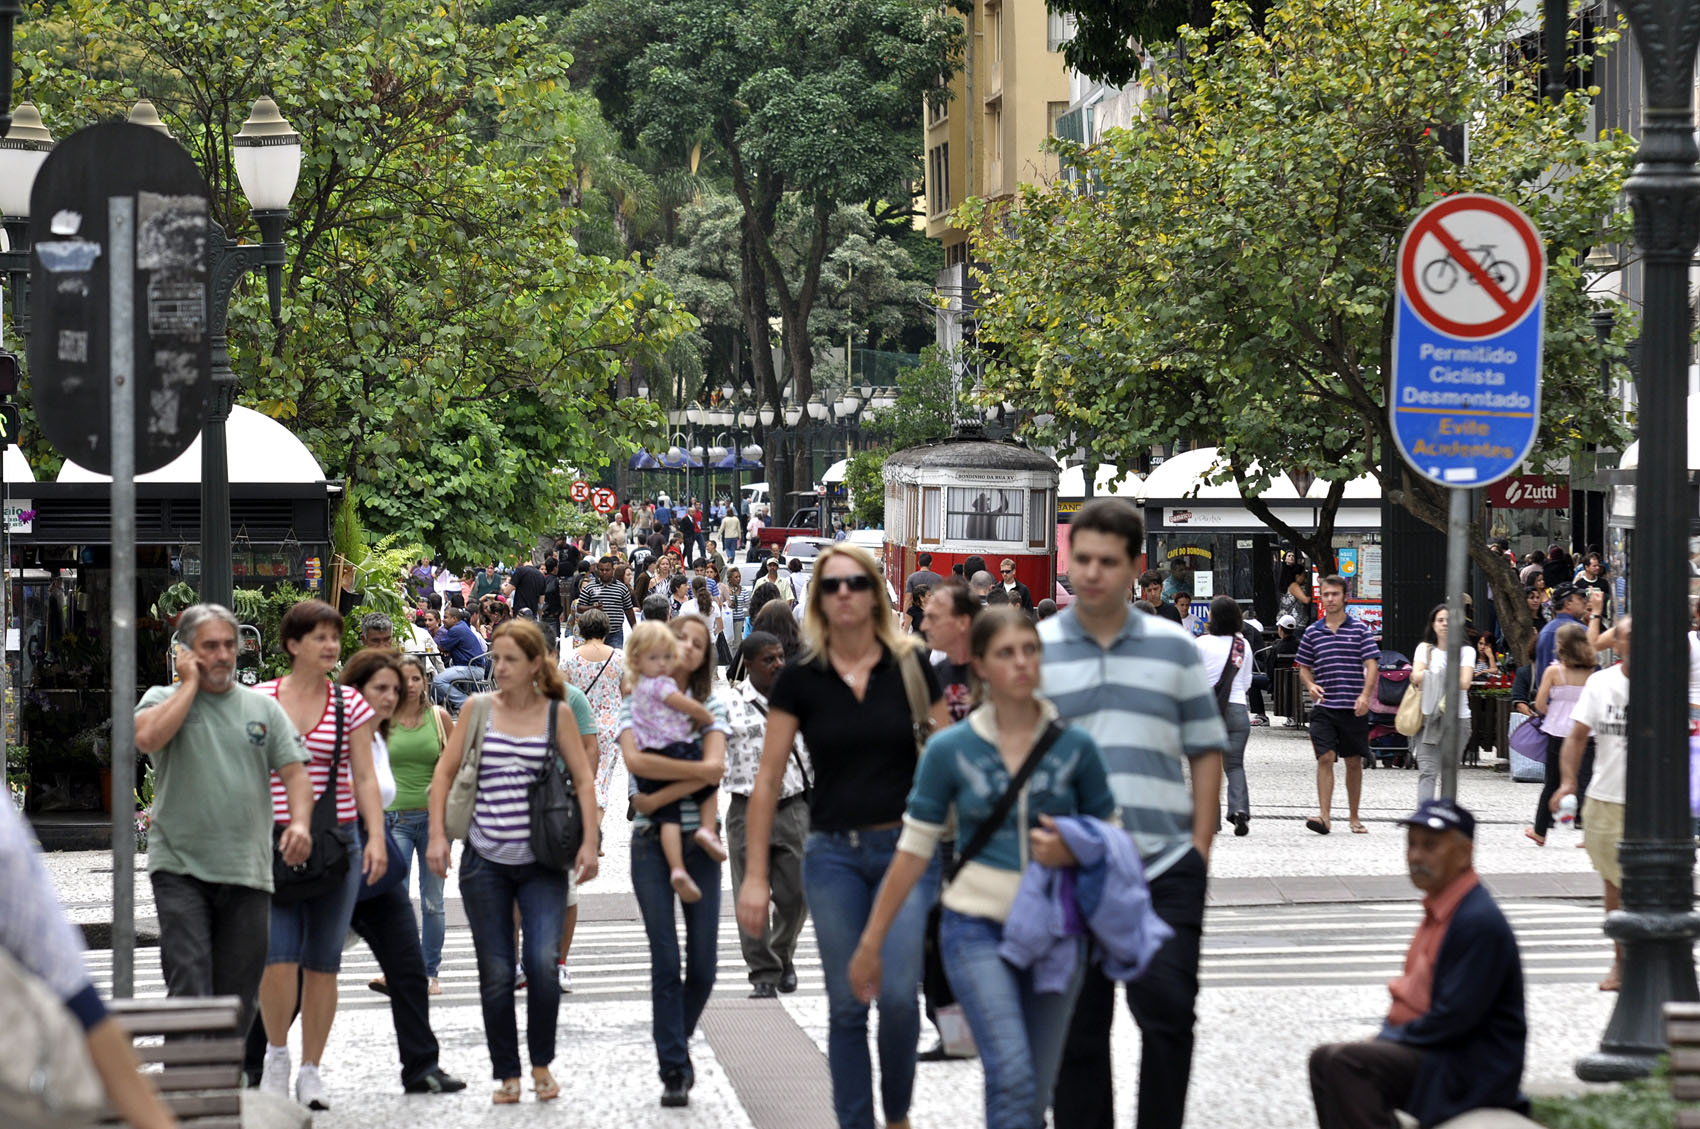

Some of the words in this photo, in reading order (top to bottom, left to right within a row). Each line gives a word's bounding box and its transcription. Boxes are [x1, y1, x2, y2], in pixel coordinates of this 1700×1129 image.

[1419, 343, 1518, 364] Permitido
[1429, 365, 1506, 386] Ciclista
[1402, 386, 1531, 409] Desmontado
[1439, 417, 1491, 437] Evite
[1523, 483, 1557, 499] Zutti
[1167, 547, 1179, 559] CAFÉ
[1179, 547, 1187, 556] DO
[1187, 547, 1212, 560] BONDINHO
